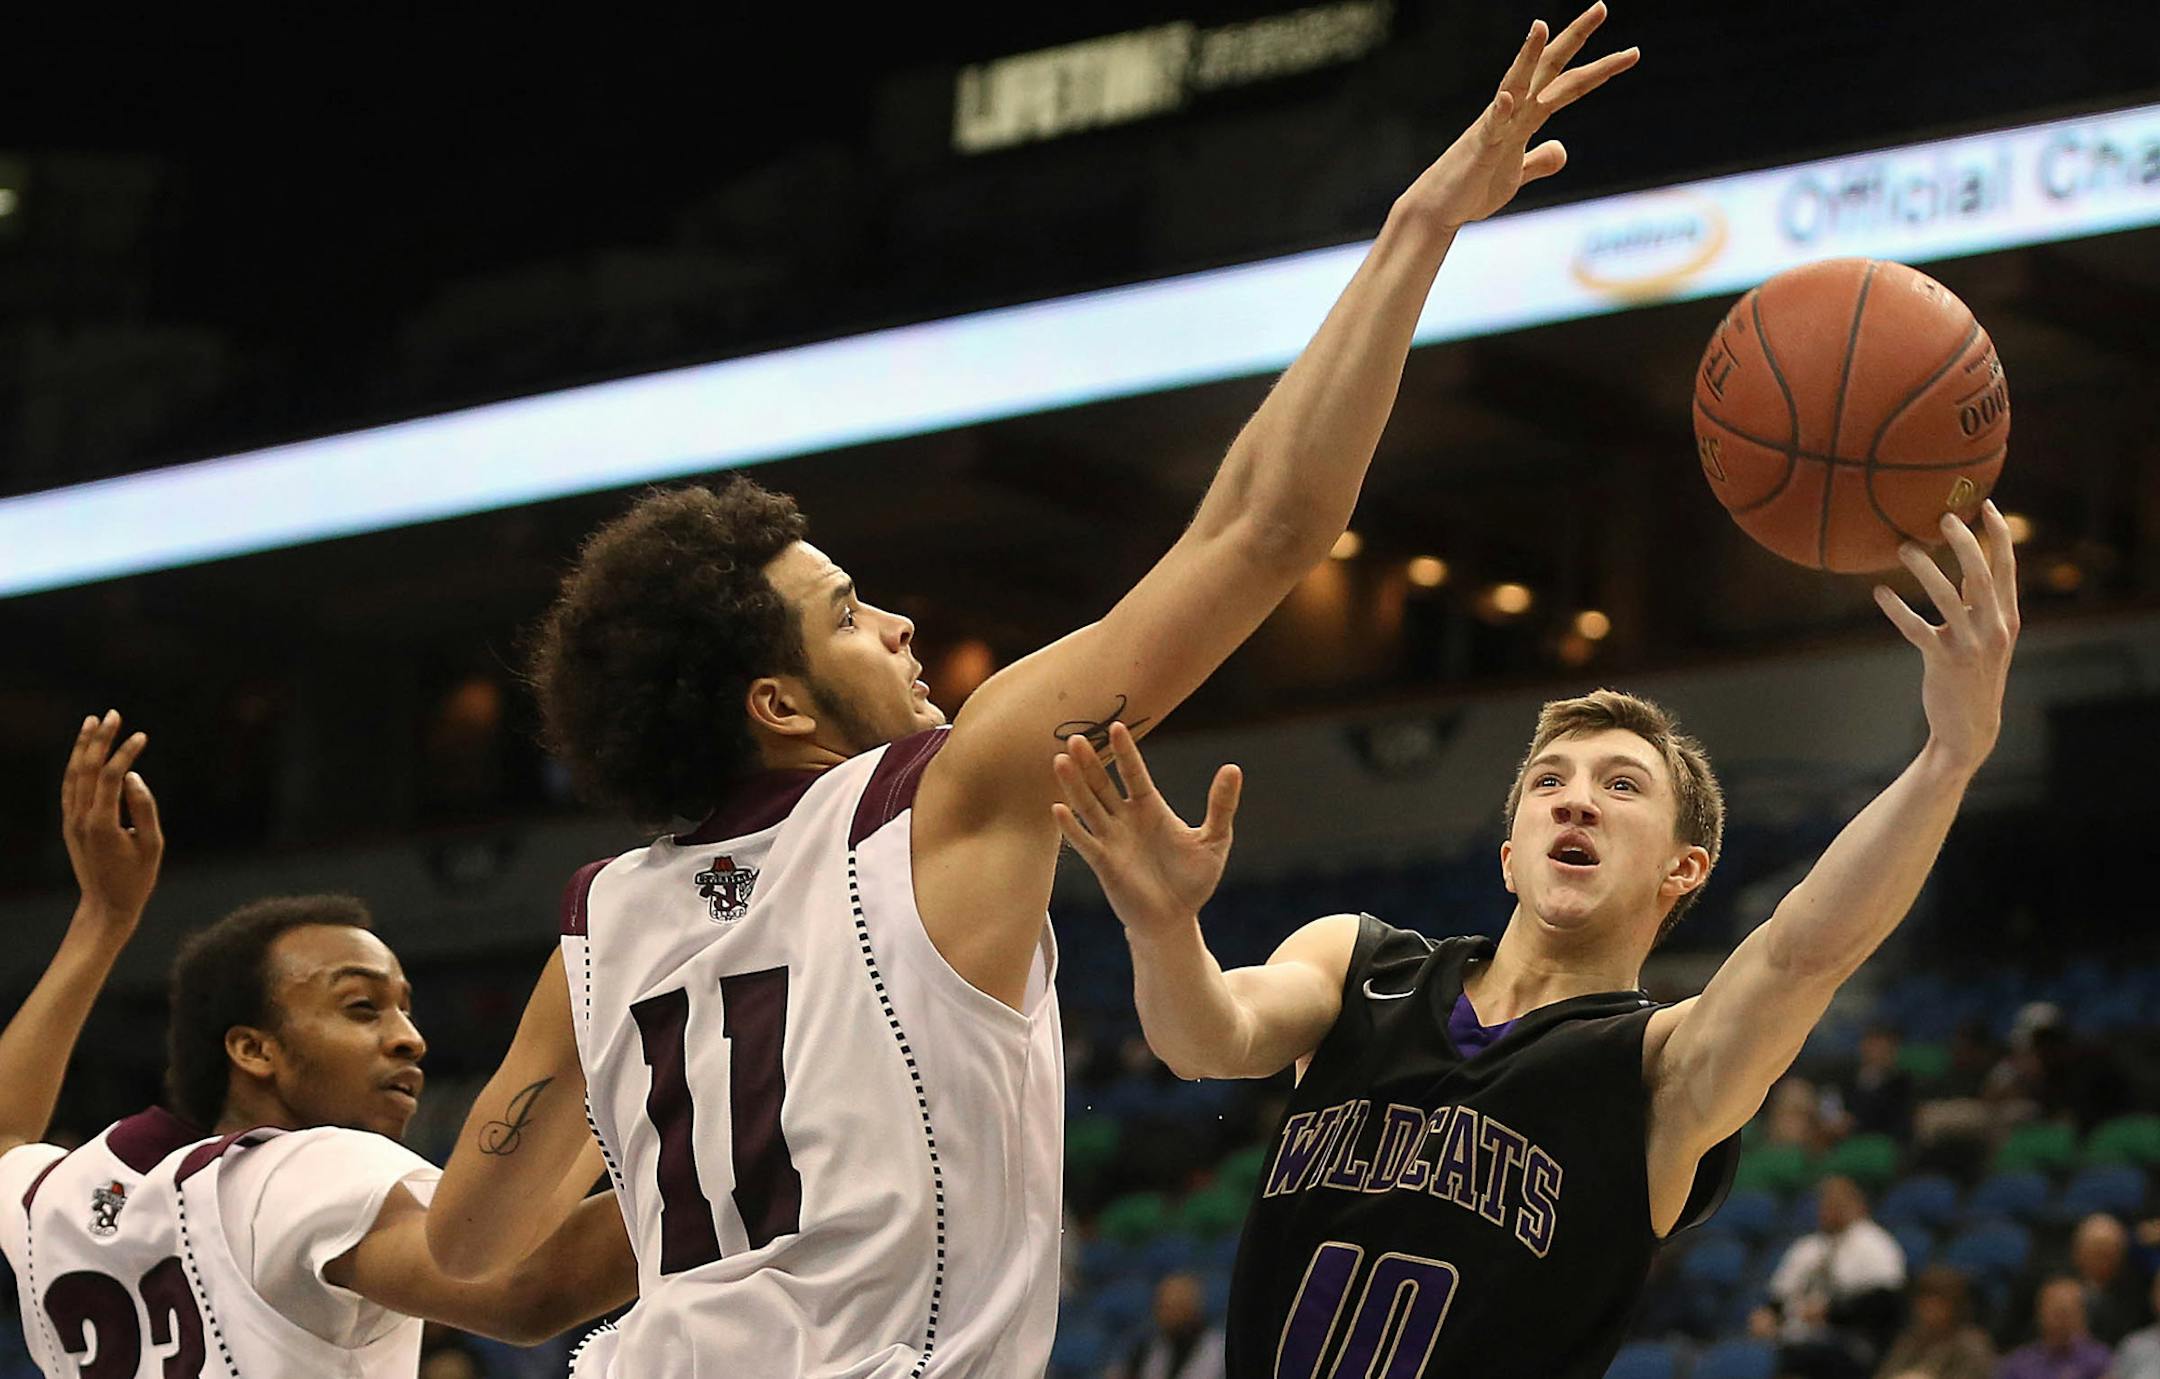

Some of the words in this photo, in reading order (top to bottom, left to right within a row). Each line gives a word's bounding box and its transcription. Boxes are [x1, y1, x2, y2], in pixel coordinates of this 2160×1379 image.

[629, 966, 802, 1276] 11
[1263, 1100, 1564, 1260] WILDCATS
[1274, 1240, 1460, 1379] 10
